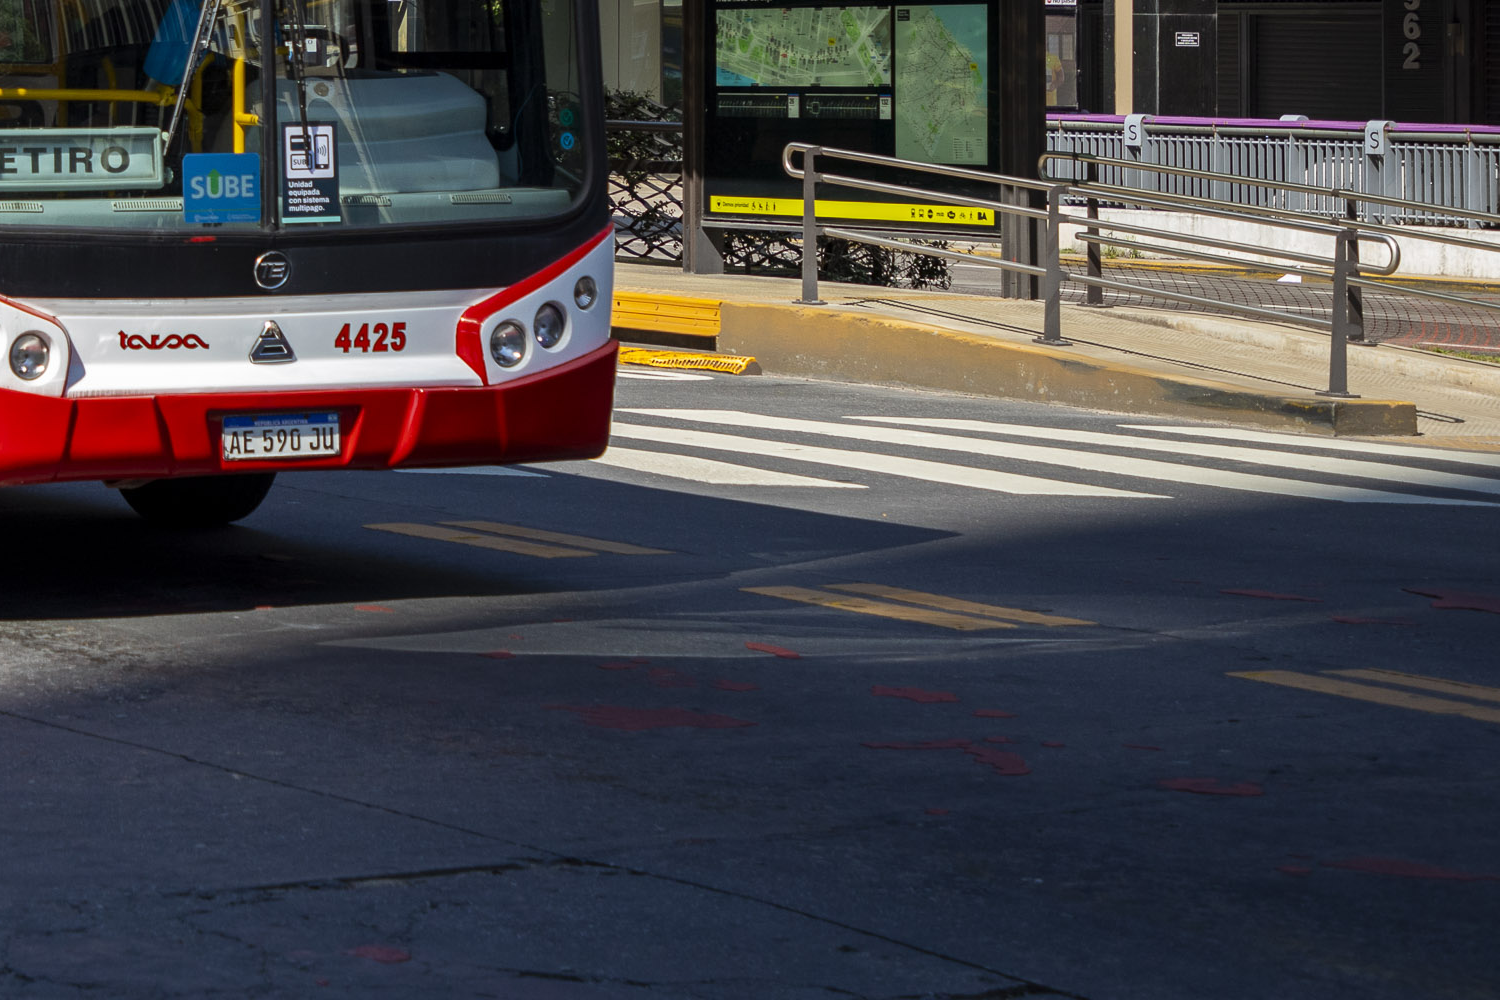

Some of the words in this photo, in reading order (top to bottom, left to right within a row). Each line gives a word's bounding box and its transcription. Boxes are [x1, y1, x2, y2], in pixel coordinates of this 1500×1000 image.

[1128, 124, 1137, 141] S
[1370, 131, 1380, 149] S
[190, 174, 255, 199] SUBE
[335, 323, 407, 353] 4425
[230, 430, 255, 454] AE
[263, 428, 301, 453] 590
[310, 427, 334, 450] JU
